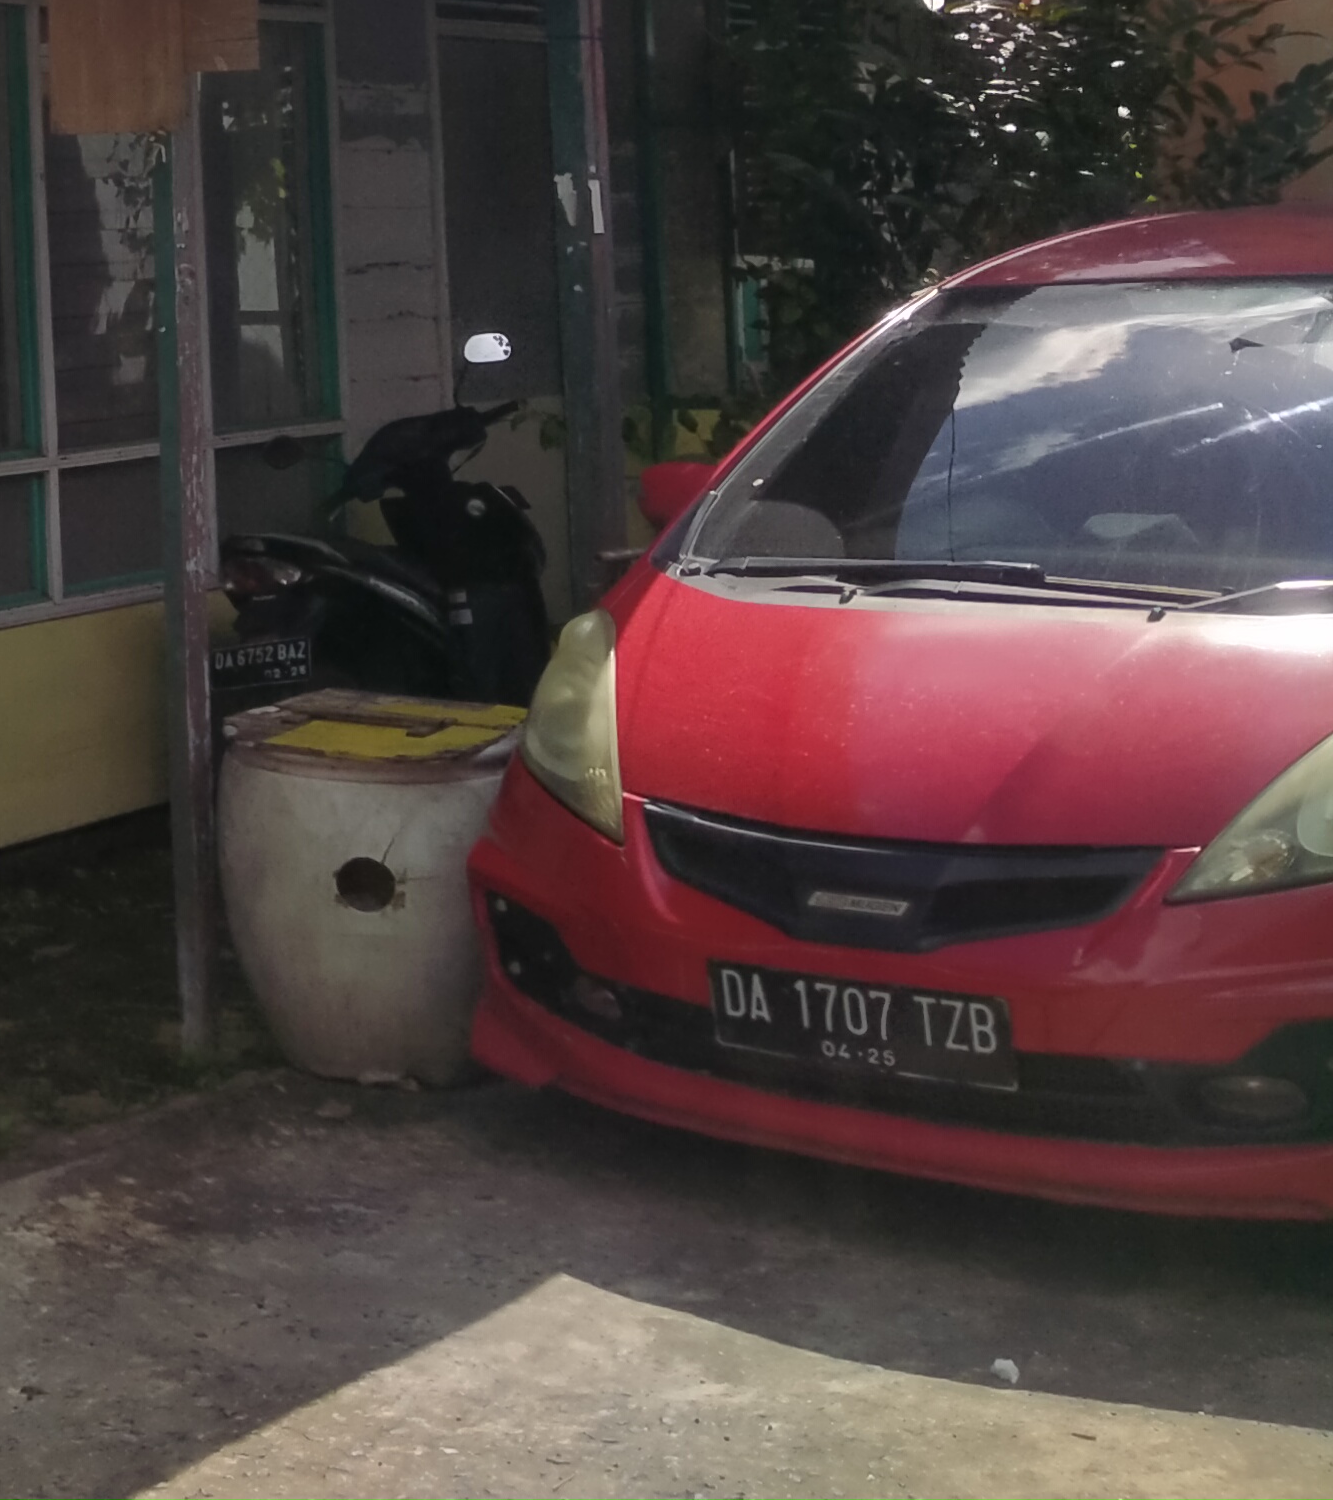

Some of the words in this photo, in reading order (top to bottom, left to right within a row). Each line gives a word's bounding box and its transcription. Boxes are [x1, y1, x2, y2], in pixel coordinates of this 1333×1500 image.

[214, 652, 234, 669] DA
[237, 646, 274, 666] 6752
[277, 641, 306, 660] BAZ
[720, 968, 770, 1022] DA
[794, 979, 892, 1041] 1707
[914, 995, 998, 1054] TZB
